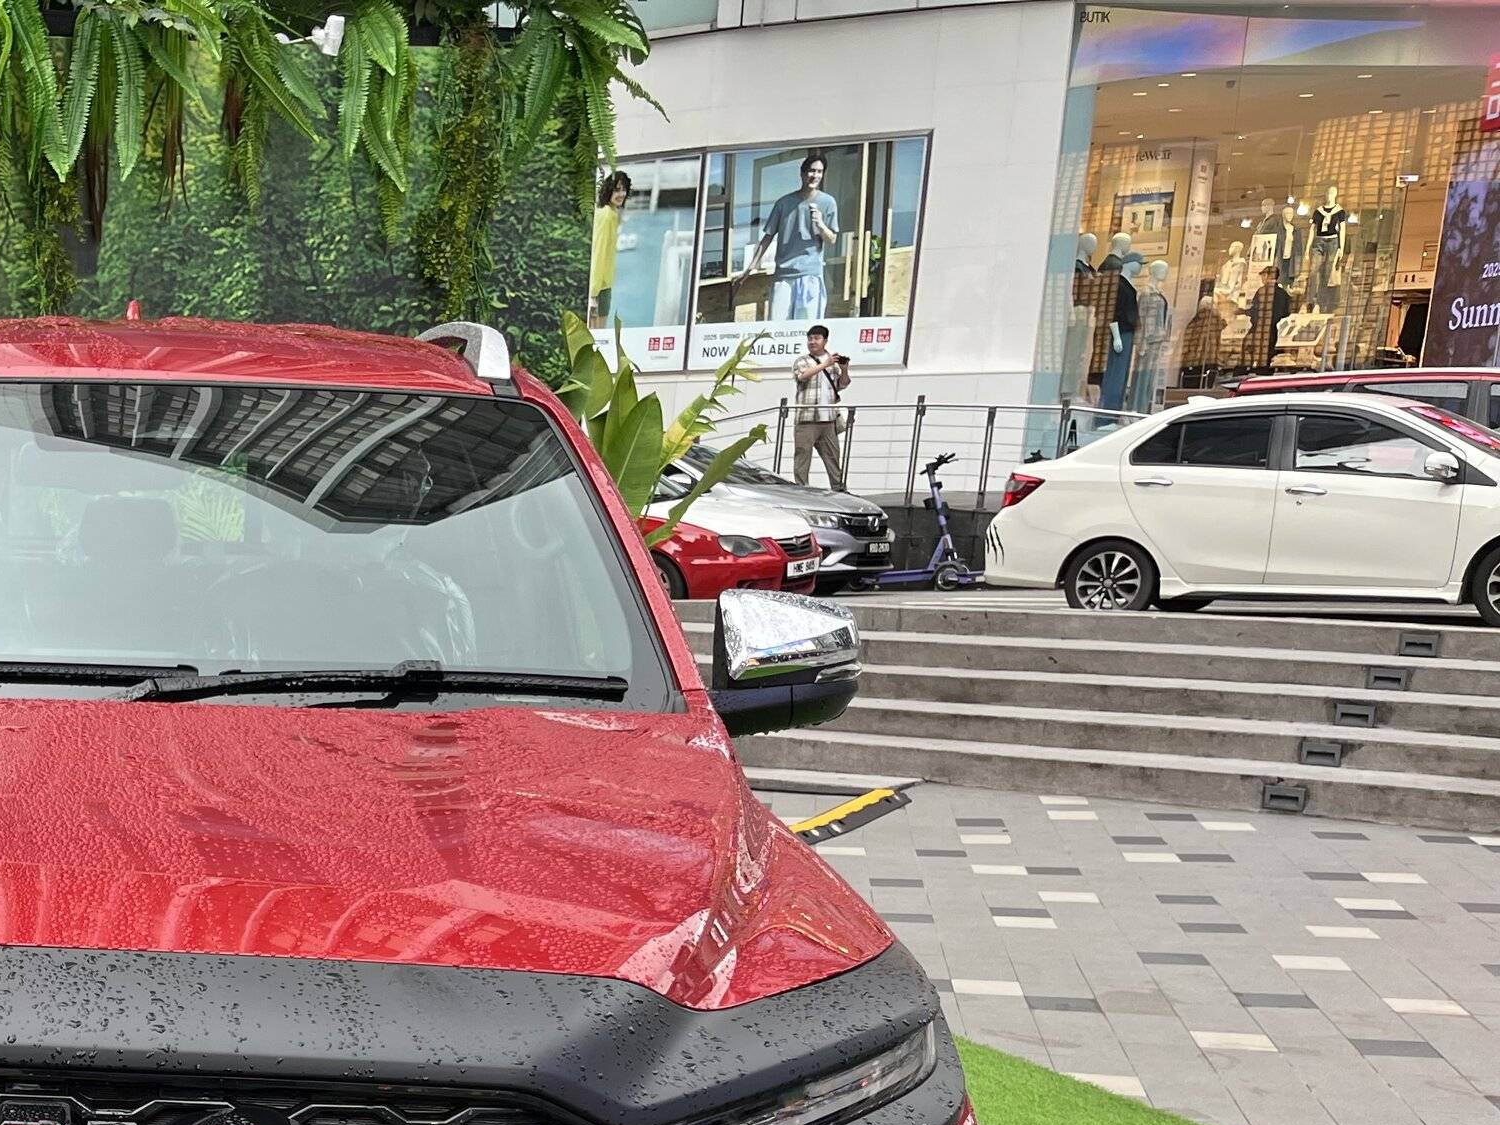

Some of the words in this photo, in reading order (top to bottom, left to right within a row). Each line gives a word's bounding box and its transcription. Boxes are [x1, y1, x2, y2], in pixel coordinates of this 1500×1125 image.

[1079, 11, 1111, 23] BUTIK
[702, 345, 730, 358] NOW
[745, 343, 801, 356] AILABLE
